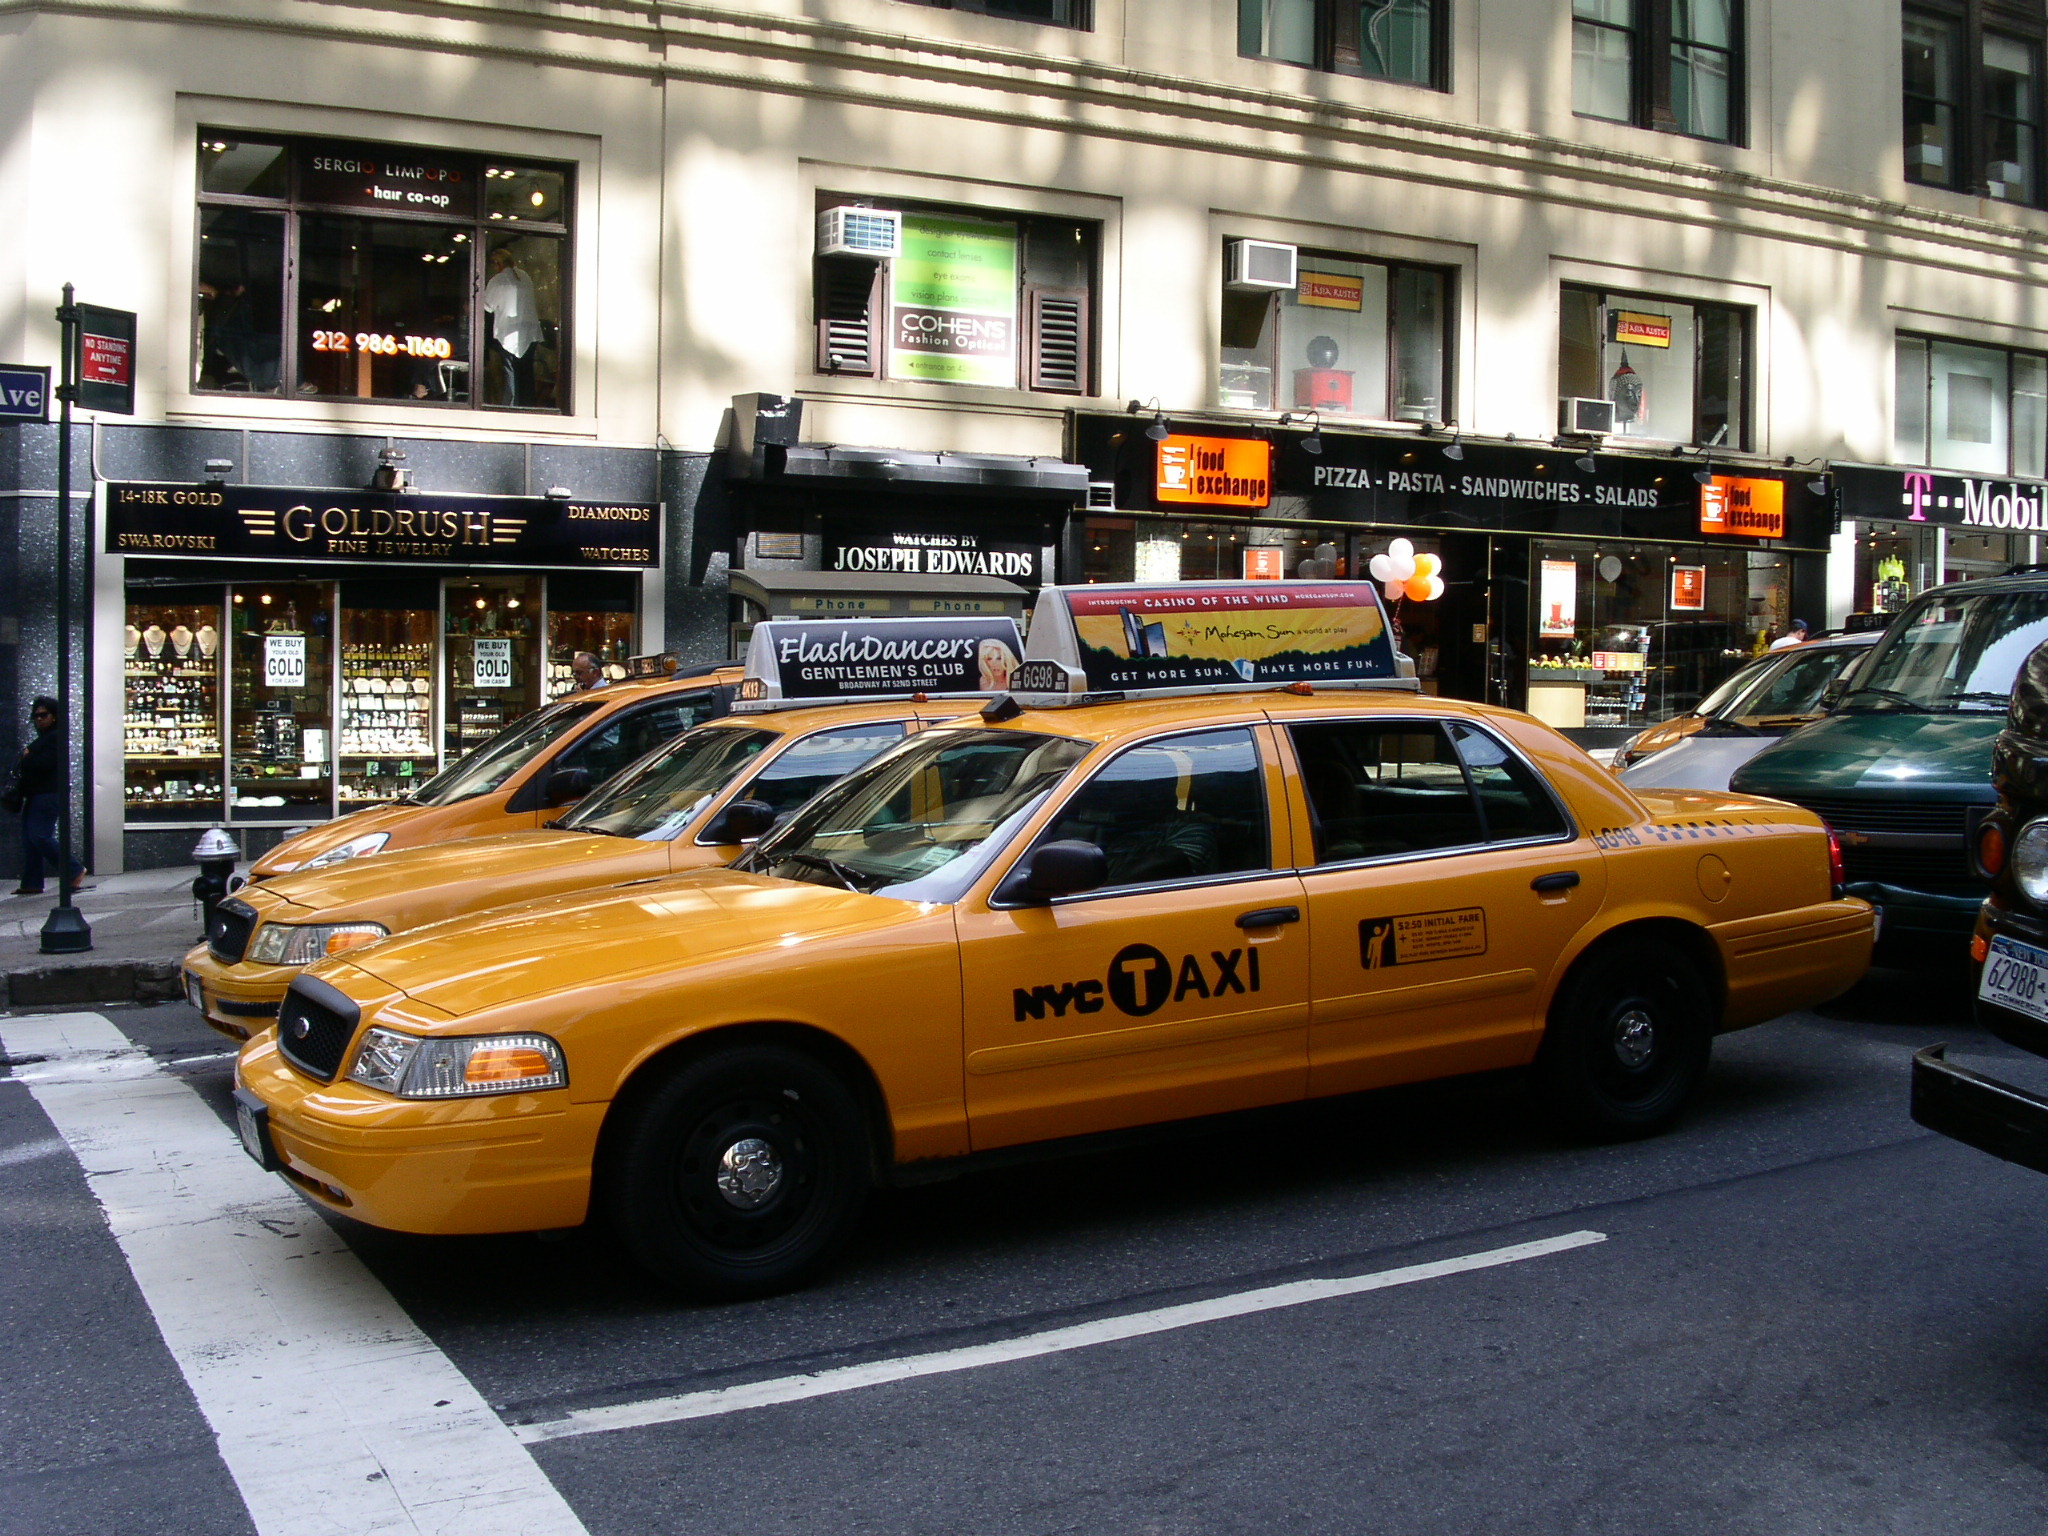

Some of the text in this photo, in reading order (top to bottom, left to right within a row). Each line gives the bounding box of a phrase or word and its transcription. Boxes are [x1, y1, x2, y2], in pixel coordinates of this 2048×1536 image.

[313, 157, 462, 183] SERGIO LIMPOPO
[373, 185, 450, 208] hair co-op
[927, 249, 982, 262] contact lenses
[933, 271, 948, 281] eye
[911, 288, 935, 300] vision
[937, 290, 959, 303] plans
[1314, 286, 1332, 296] ASIA
[85, 338, 127, 353] NO STANDING
[312, 330, 452, 359] 212 986-1160
[901, 330, 1006, 351] Fashion Optical
[90, 352, 122, 365] ANYTIME
[1197, 446, 1225, 472] food
[1197, 472, 1266, 501] exchange
[1314, 465, 1370, 489] PIZZA
[1388, 471, 1445, 494] PASTA
[1461, 475, 1580, 503] SANDWICHES
[1594, 485, 1659, 508] SALADS
[1730, 484, 1751, 506] food
[119, 489, 223, 506] 14-18K GOLD
[568, 505, 651, 521] DIAMONDS
[1730, 508, 1780, 532] exchange
[282, 505, 491, 546] GOLDRUSH
[118, 533, 216, 549] SWAROVSKI
[327, 539, 453, 556] FINE JEWELRY
[893, 532, 979, 547] WATCHES BY
[580, 546, 651, 561] WATCHES
[833, 547, 1033, 576] JOSEPH EDWARDS
[815, 599, 866, 610] Phone
[933, 600, 982, 612] Phone
[1143, 597, 1196, 608] CASINO
[1201, 596, 1218, 606] OF
[1223, 594, 1250, 605] THE
[1253, 594, 1289, 604] WIND
[1205, 625, 1266, 642] Mohegan
[1266, 625, 1295, 639] Sun
[1303, 627, 1323, 635] world
[1333, 626, 1348, 635] play
[270, 639, 302, 647] WE BUY
[491, 642, 508, 650] BUY
[780, 630, 975, 664] FlashDancers
[268, 657, 303, 676] GOLD
[476, 659, 509, 677] GOLD
[801, 663, 965, 681] GENTLEMEN'S CLUB
[1111, 667, 1230, 682] GET MORE SUN.
[1260, 660, 1379, 674] HAVE MORE FUN.
[839, 678, 938, 690] BROADWAY AT 52ND STREET
[1024, 665, 1053, 688] 6G98
[1590, 827, 1641, 850] 6G98
[1424, 916, 1455, 928] INITIAL
[1458, 913, 1480, 923] FARE
[1988, 957, 2038, 999] 62988
[1013, 979, 1104, 1022] NYC
